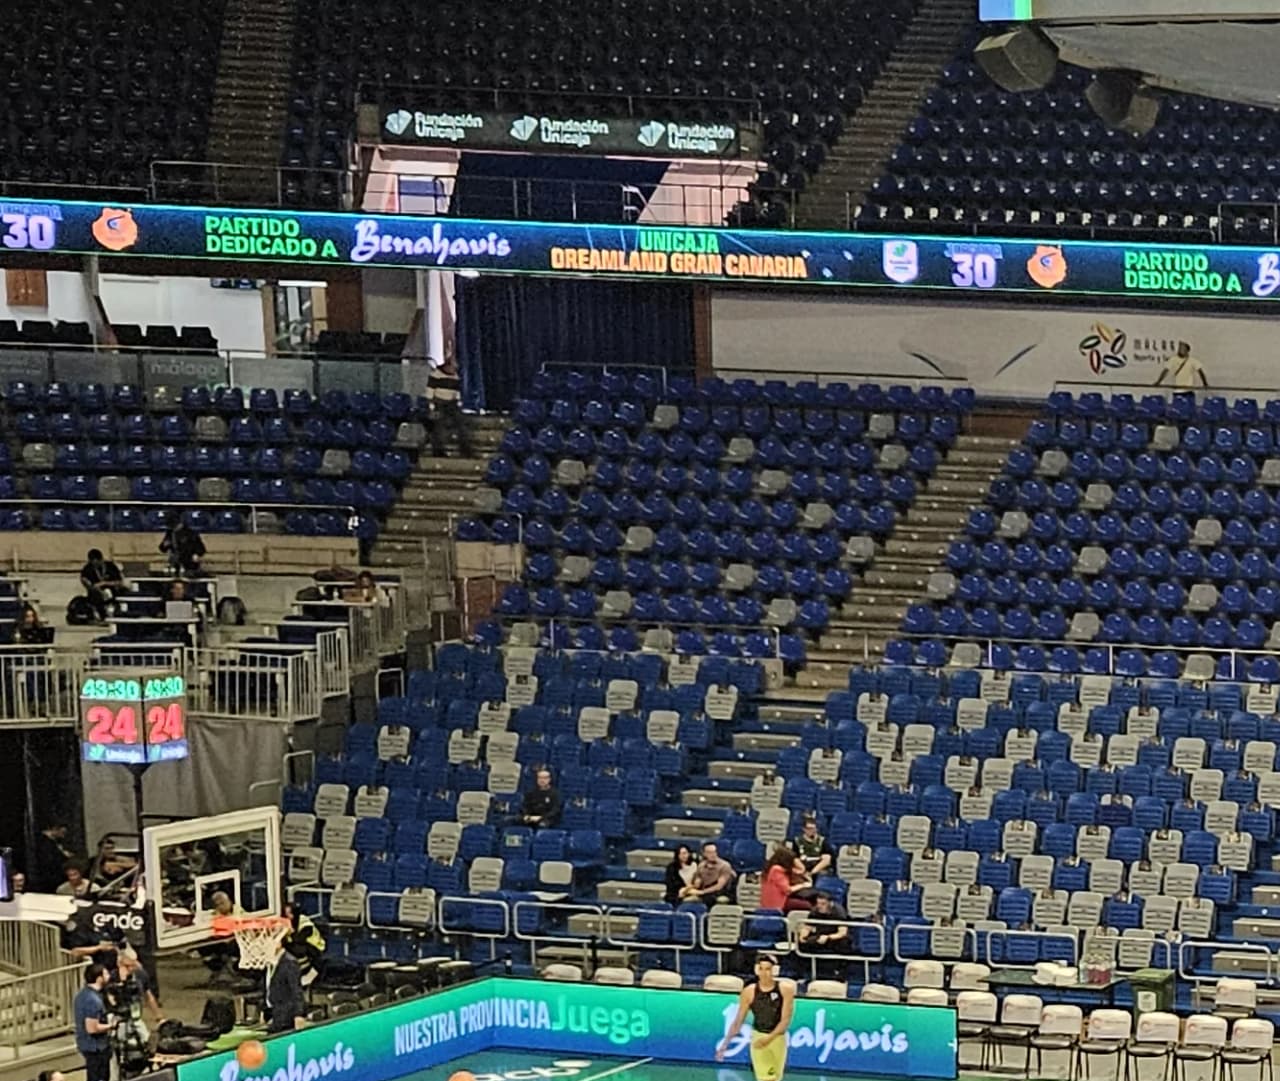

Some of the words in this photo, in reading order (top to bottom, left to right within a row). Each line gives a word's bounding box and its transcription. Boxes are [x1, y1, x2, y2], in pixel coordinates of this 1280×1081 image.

[416, 125, 465, 141] Unicaja
[541, 130, 592, 147] Unicaja
[668, 136, 718, 152] Unicaja
[2, 213, 57, 249] 30
[205, 215, 300, 236] PARTIDO
[205, 236, 317, 258] DEDICADO
[321, 239, 339, 258] A
[640, 231, 719, 253] UNICAJA
[551, 248, 666, 273] DREAMLAND
[671, 252, 722, 275] GRAN
[725, 254, 807, 278] CANARIA
[952, 254, 997, 288] 30
[1124, 251, 1208, 272] PARTIDO
[1124, 271, 1221, 291] DEDICADO
[1226, 273, 1241, 292] A
[87, 706, 137, 744] 24
[148, 703, 183, 743] 24
[93, 912, 145, 931] ende
[394, 1009, 458, 1056] NUESTRA
[460, 997, 551, 1034] PROVINCIA
[551, 1001, 650, 1044] Juega
[716, 1004, 908, 1063] Bahavis
